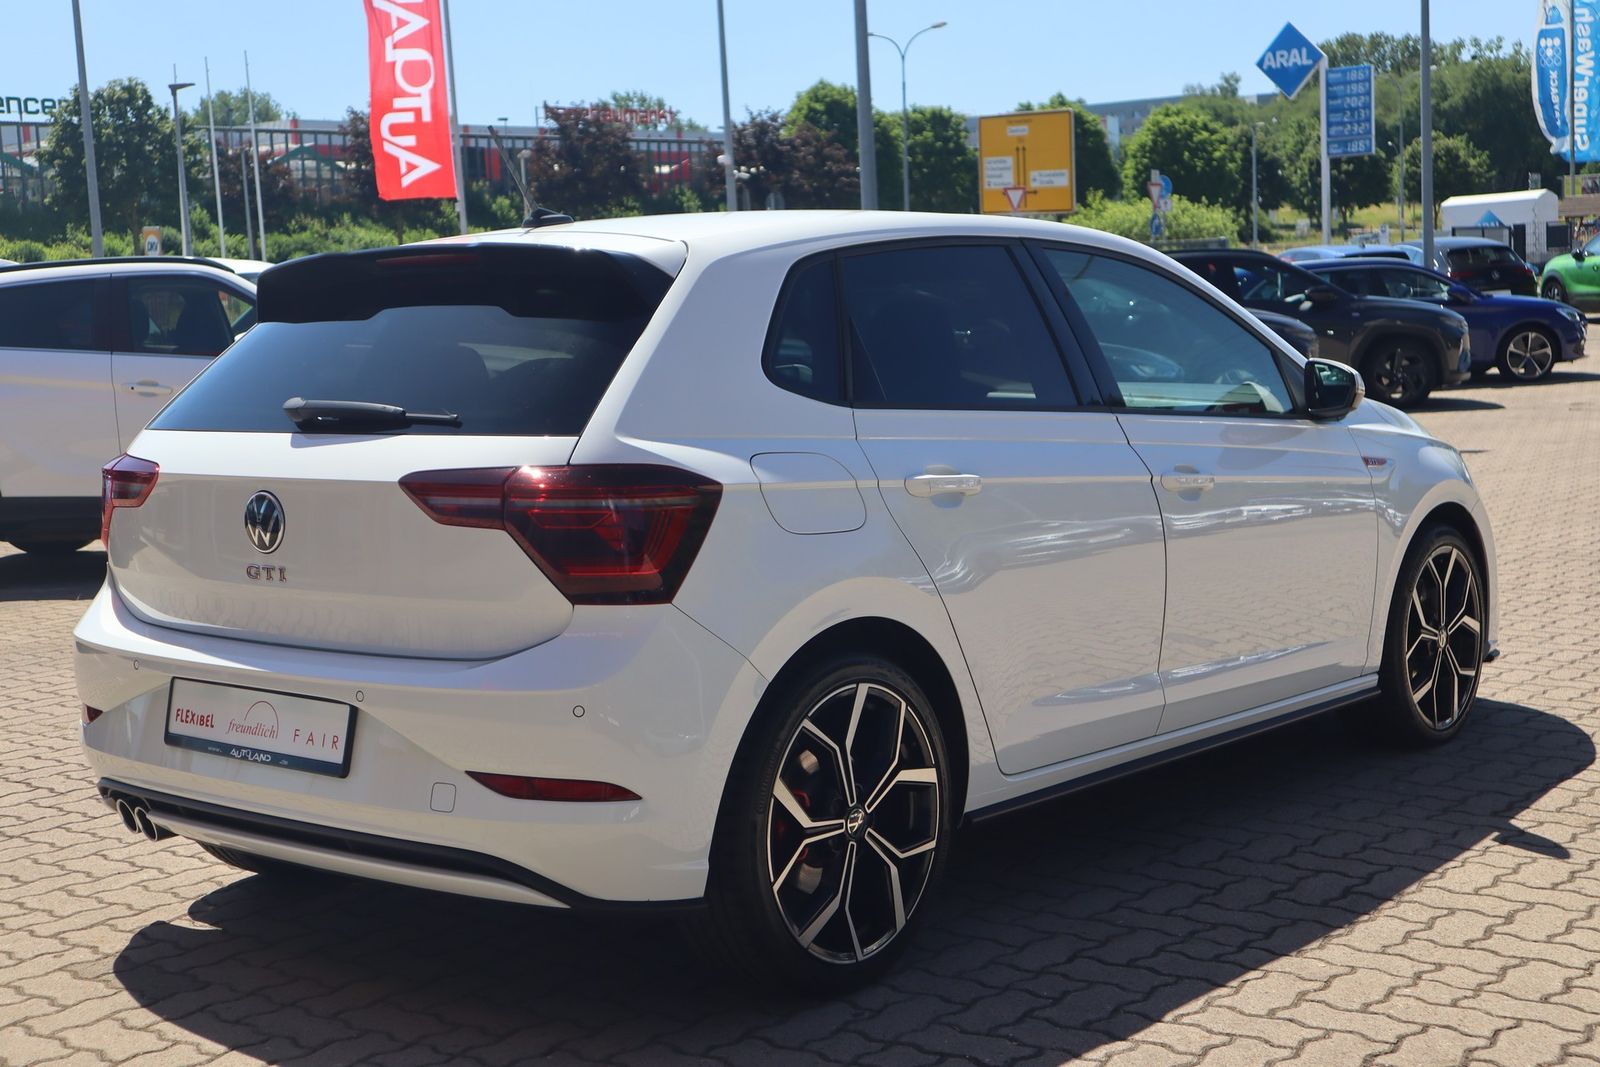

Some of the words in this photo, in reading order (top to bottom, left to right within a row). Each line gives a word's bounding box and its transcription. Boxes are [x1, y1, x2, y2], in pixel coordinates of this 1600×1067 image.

[1262, 47, 1313, 70] ARAL
[246, 563, 287, 583] GTI
[225, 717, 278, 740] freundlich
[230, 748, 272, 763] AUTOLAND
